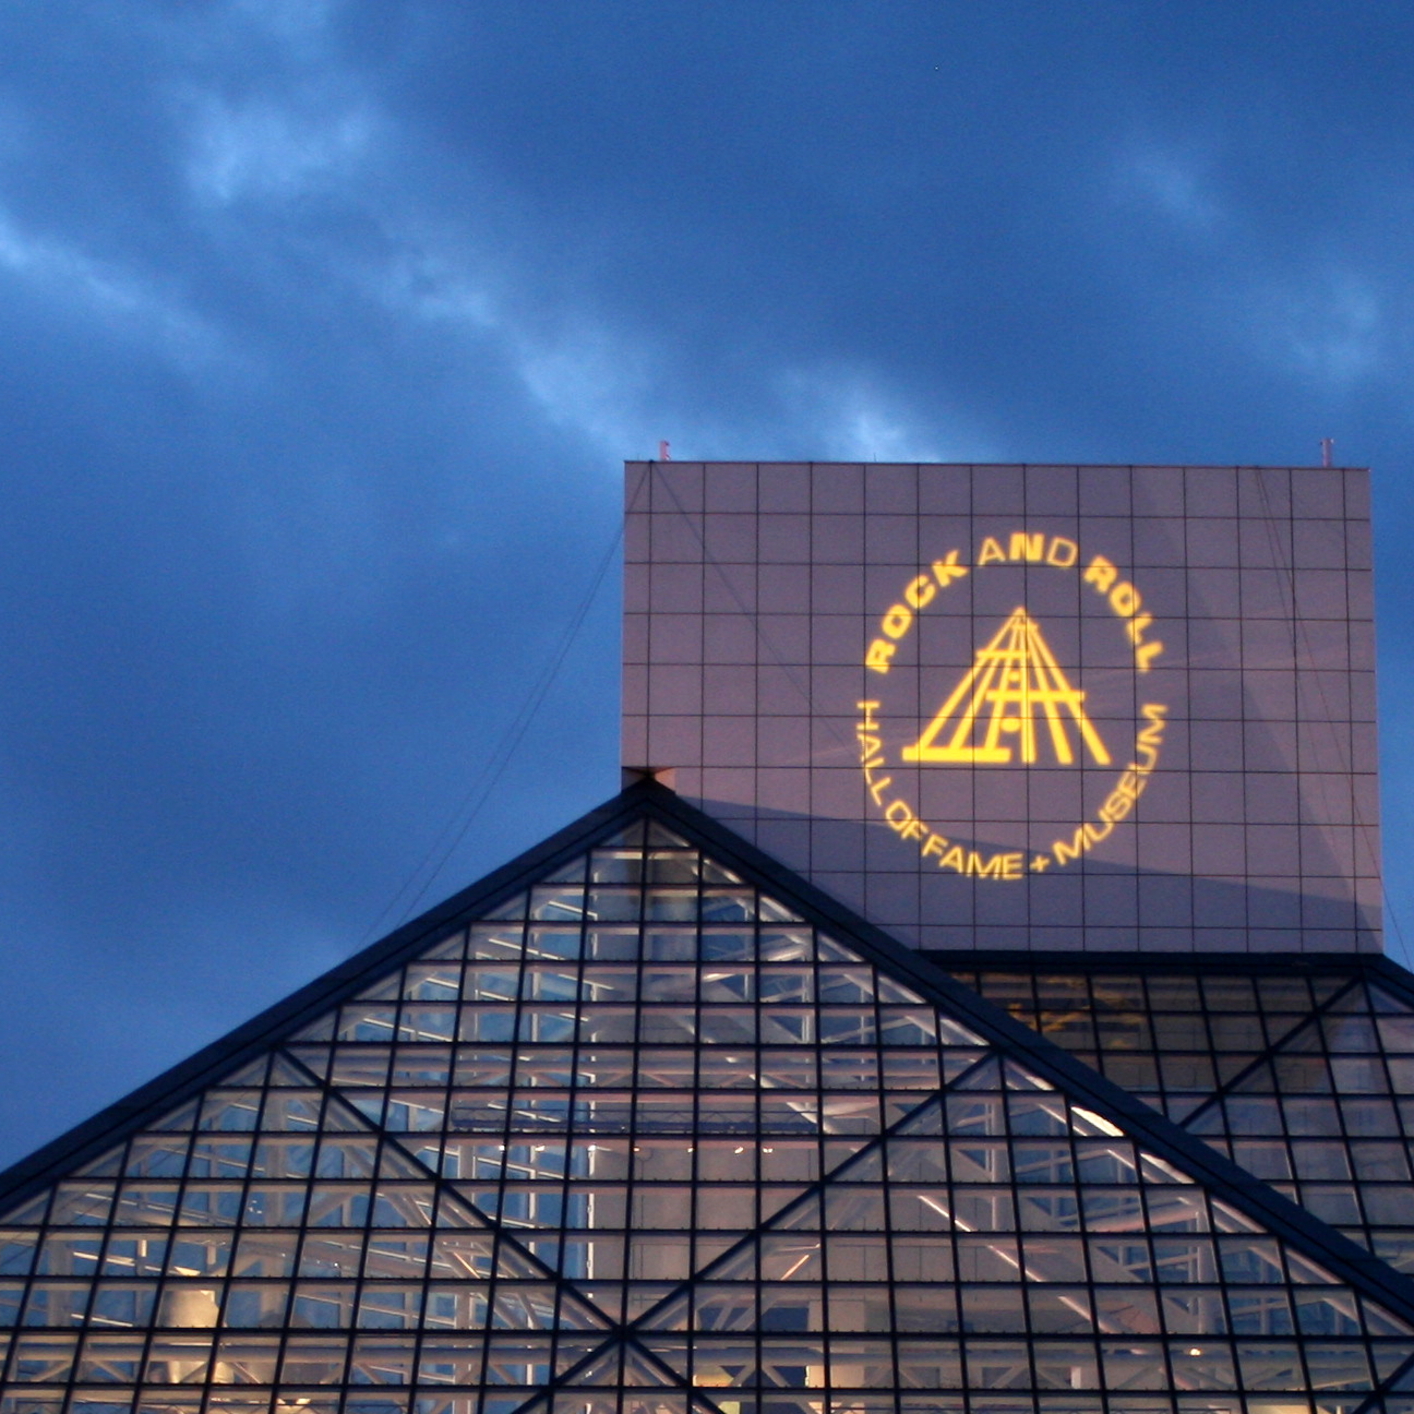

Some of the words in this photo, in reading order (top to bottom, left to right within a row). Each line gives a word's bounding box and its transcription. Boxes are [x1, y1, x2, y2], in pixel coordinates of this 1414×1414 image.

[865, 550, 969, 674] ROCK
[978, 532, 1080, 568] AND
[1084, 555, 1165, 673] ROLL
[856, 700, 892, 807] HALL
[886, 800, 926, 841] OF
[922, 833, 1026, 881] FAME
[1052, 703, 1169, 866] MUSEUM
